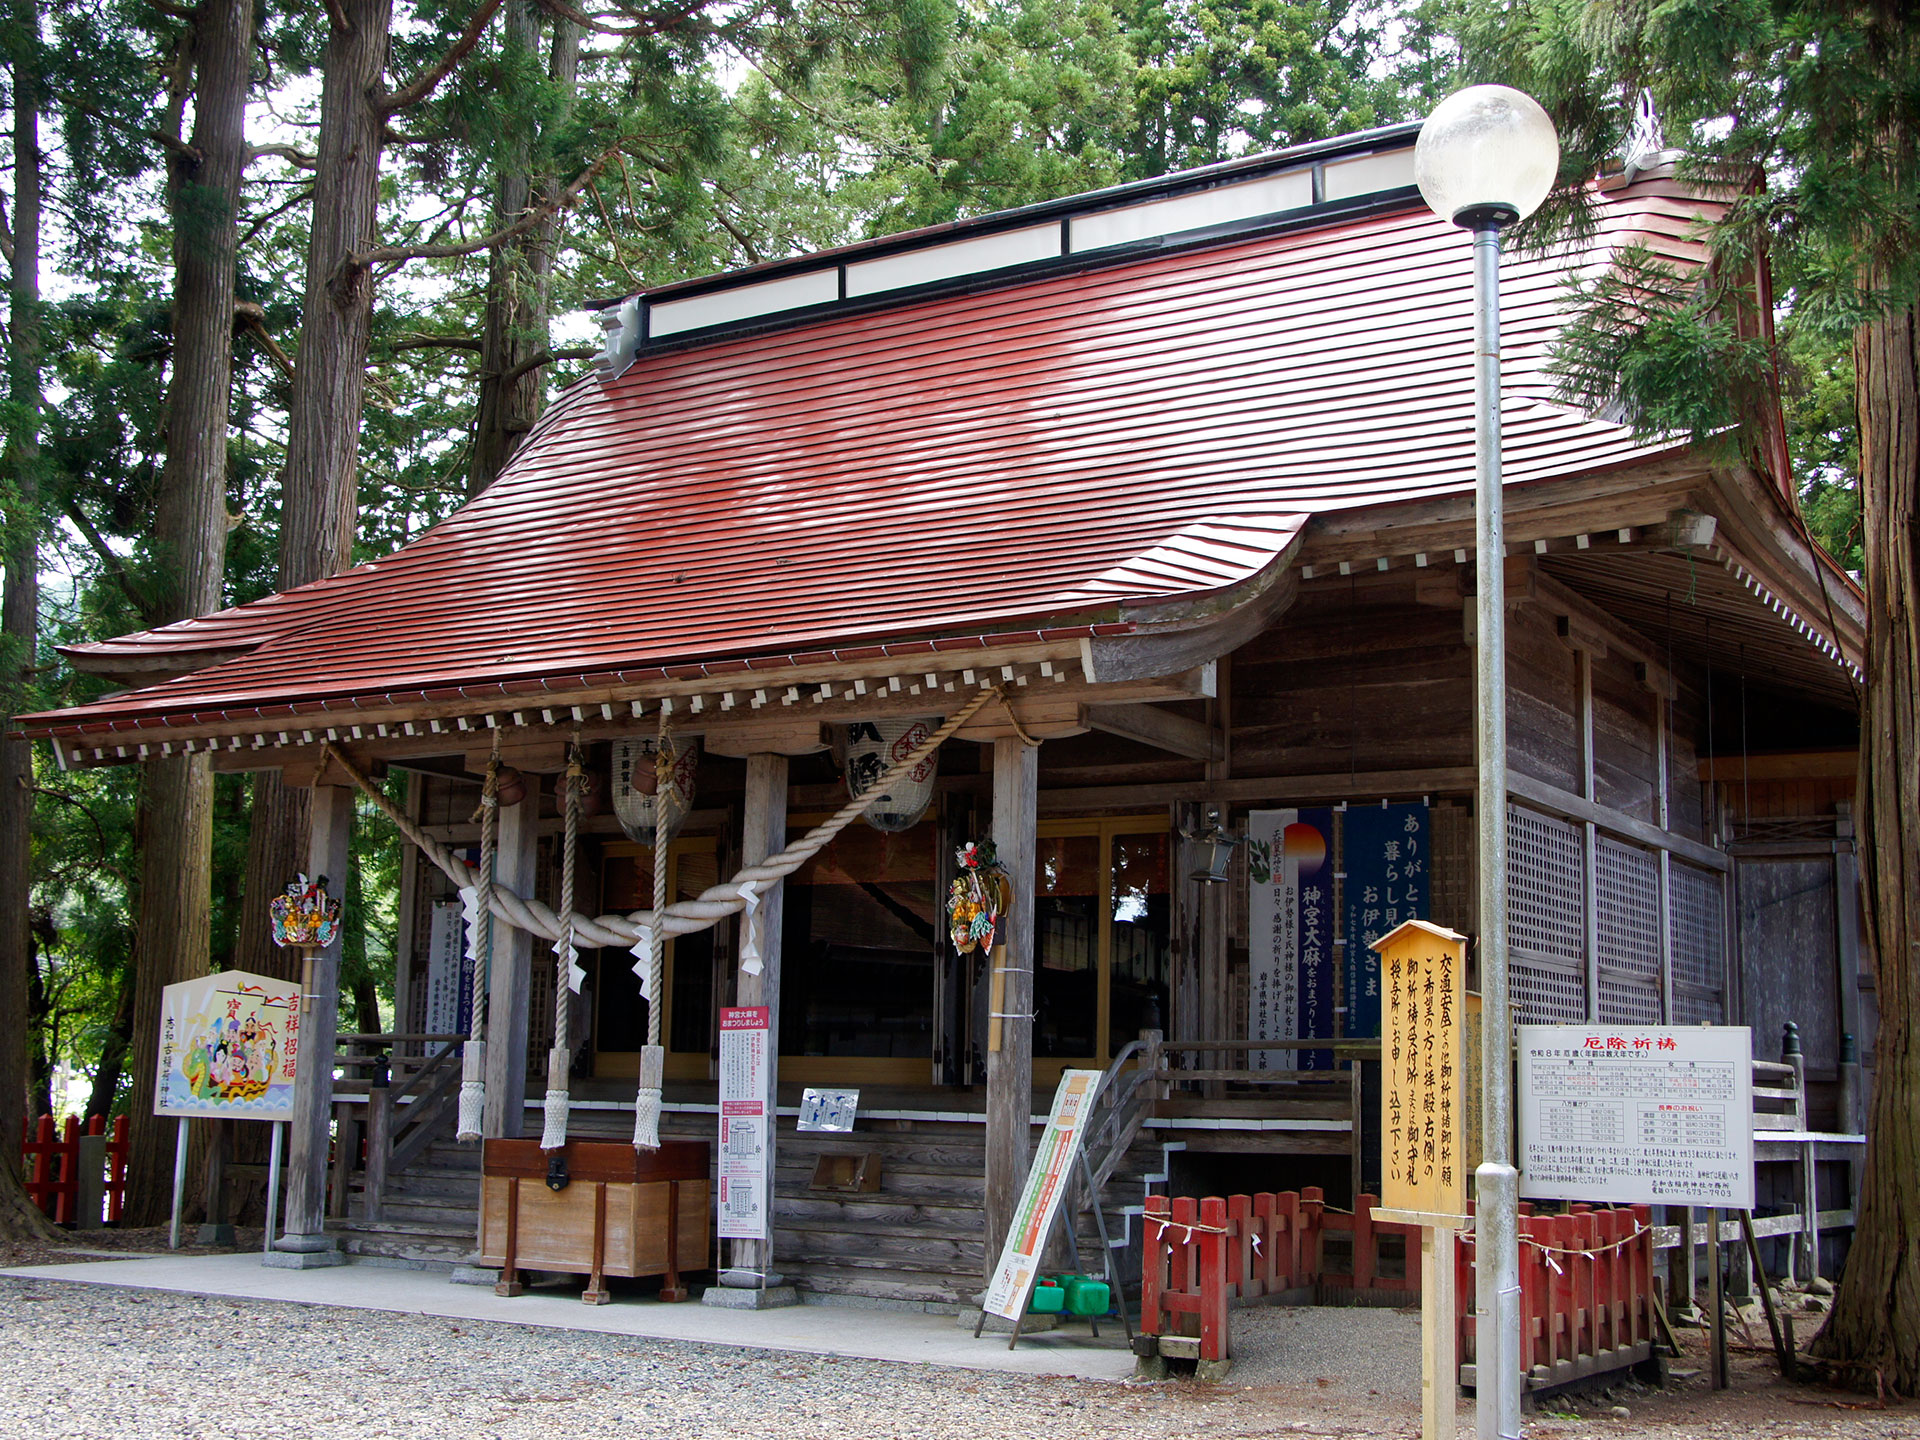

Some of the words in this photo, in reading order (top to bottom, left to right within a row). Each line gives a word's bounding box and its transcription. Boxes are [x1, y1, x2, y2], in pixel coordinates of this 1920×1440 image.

[1383, 841, 1401, 930] 暮らし見
[1404, 814, 1422, 920] ありがとう
[1284, 886, 1295, 1069] お伊勢様と氏神様の御神札をおりし
[1302, 885, 1321, 1070] 神宮大麻をおまつりしまょう
[1361, 886, 1380, 997] お伊勢さま
[283, 992, 300, 1077] 吉祥招福
[722, 1019, 764, 1027] おまつりしましょう
[728, 1011, 758, 1019] 神宮大麻を
[1423, 956, 1435, 1179] ご希望の方は拝殿右側の
[1583, 1036, 1678, 1051] 厄除祈祷
[1389, 958, 1401, 1180] 授与所にお申し込み下さい
